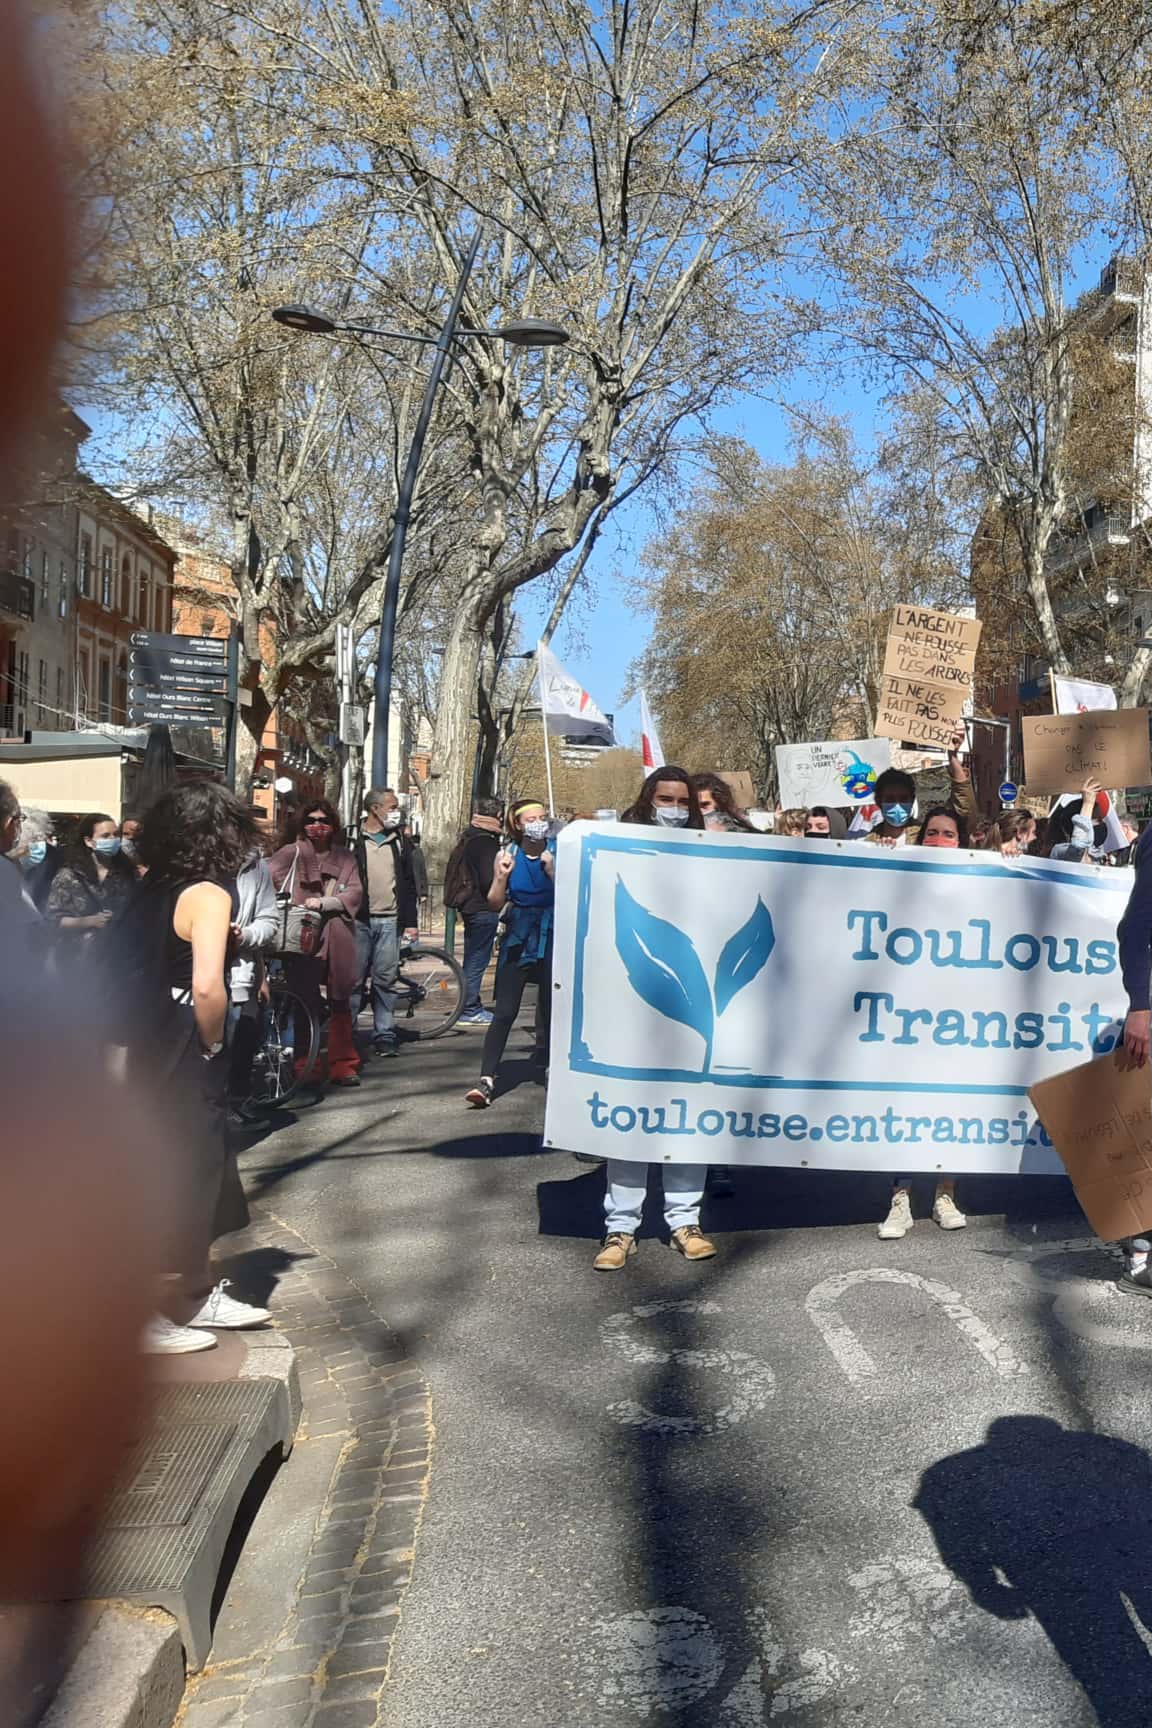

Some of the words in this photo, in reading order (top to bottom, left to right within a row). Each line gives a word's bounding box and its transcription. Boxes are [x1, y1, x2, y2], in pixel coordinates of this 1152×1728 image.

[896, 607, 969, 637] L'ARGENT
[897, 643, 919, 658] PAS
[922, 649, 956, 666] DANS
[903, 631, 923, 645] NE
[923, 635, 969, 656] POUSSE
[899, 658, 925, 674] LES
[888, 679, 903, 694] IL
[906, 685, 925, 699] NE
[925, 688, 947, 706] LES
[882, 712, 906, 727] PLUS
[886, 697, 914, 712] FAIT
[915, 702, 939, 721] PAS
